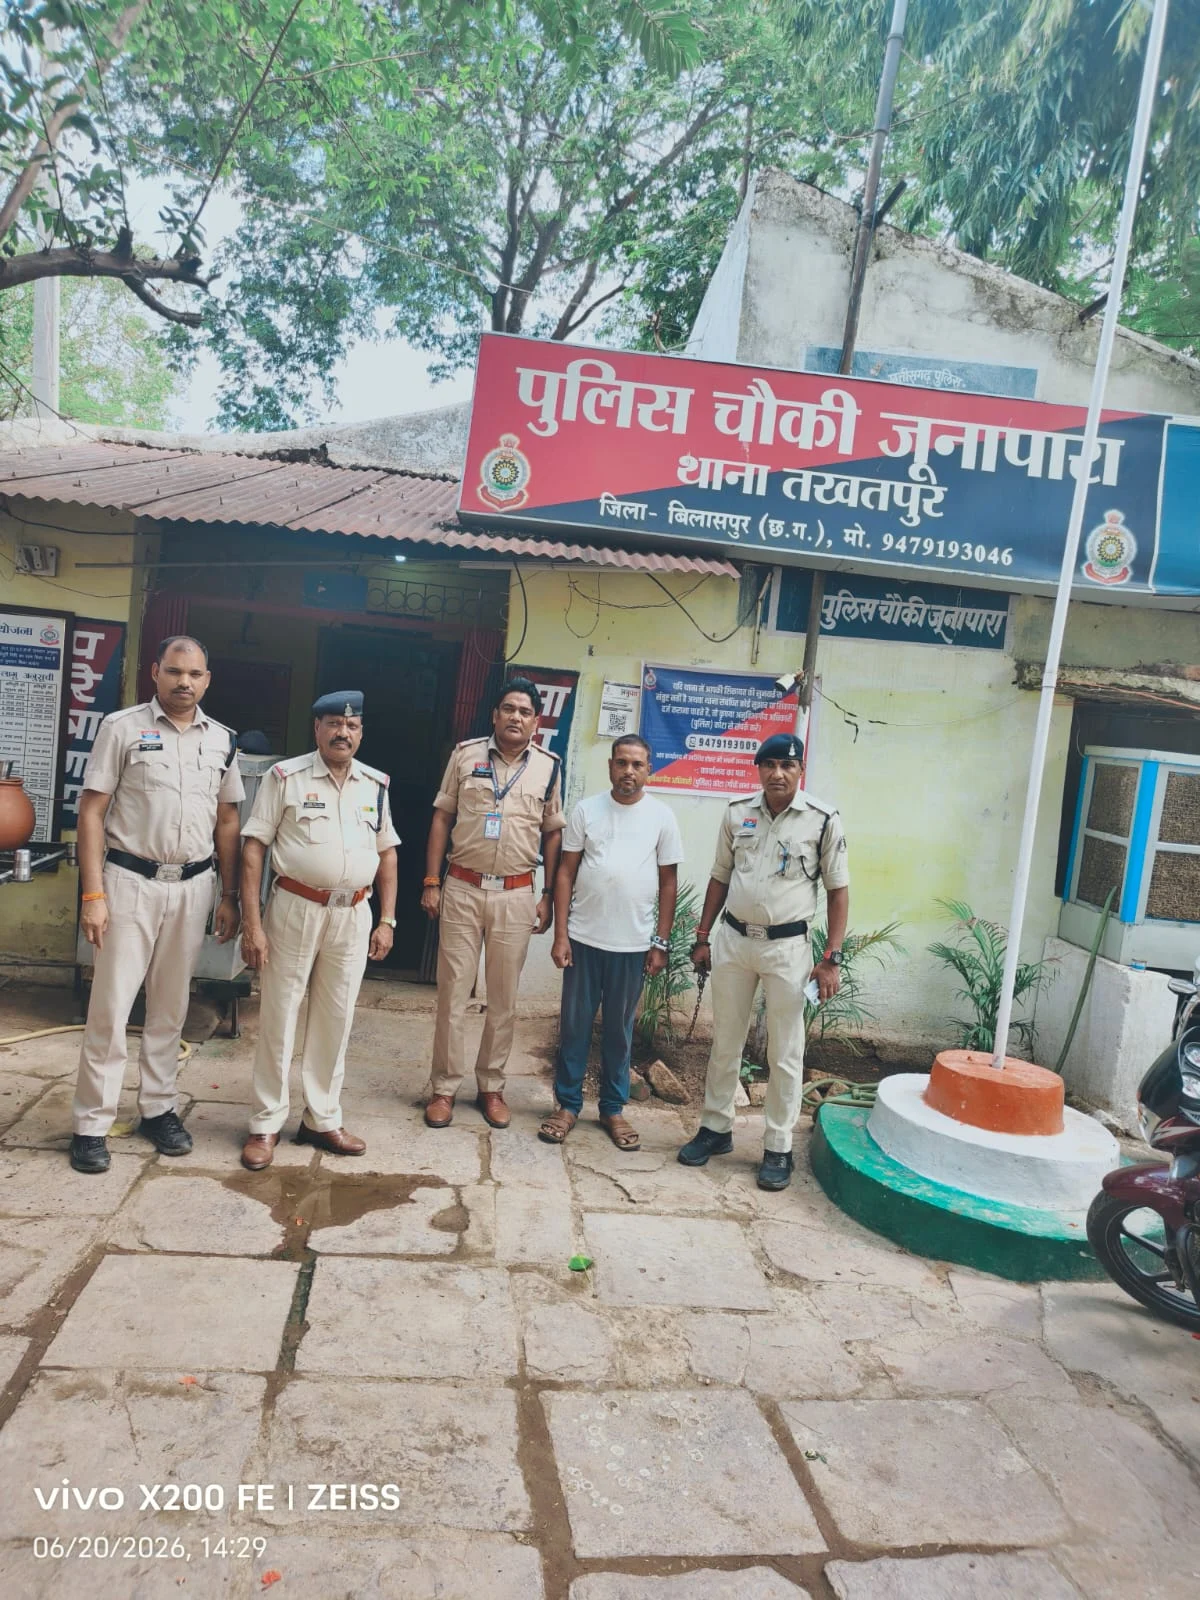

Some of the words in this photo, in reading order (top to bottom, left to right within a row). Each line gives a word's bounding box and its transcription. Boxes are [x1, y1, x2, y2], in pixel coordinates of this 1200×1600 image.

[516, 359, 694, 438] पुलिस
[712, 378, 863, 456] चौकी
[878, 411, 1125, 487] जूनापारा
[676, 453, 772, 497] थाना
[782, 466, 948, 527] तखतपुर
[668, 500, 751, 538] बिलासपुर
[843, 521, 872, 550] मो.
[881, 532, 1013, 567] 9479193046
[820, 589, 879, 630] पुलिस
[879, 592, 925, 627] चौकी
[928, 605, 1007, 644] जूनापारा
